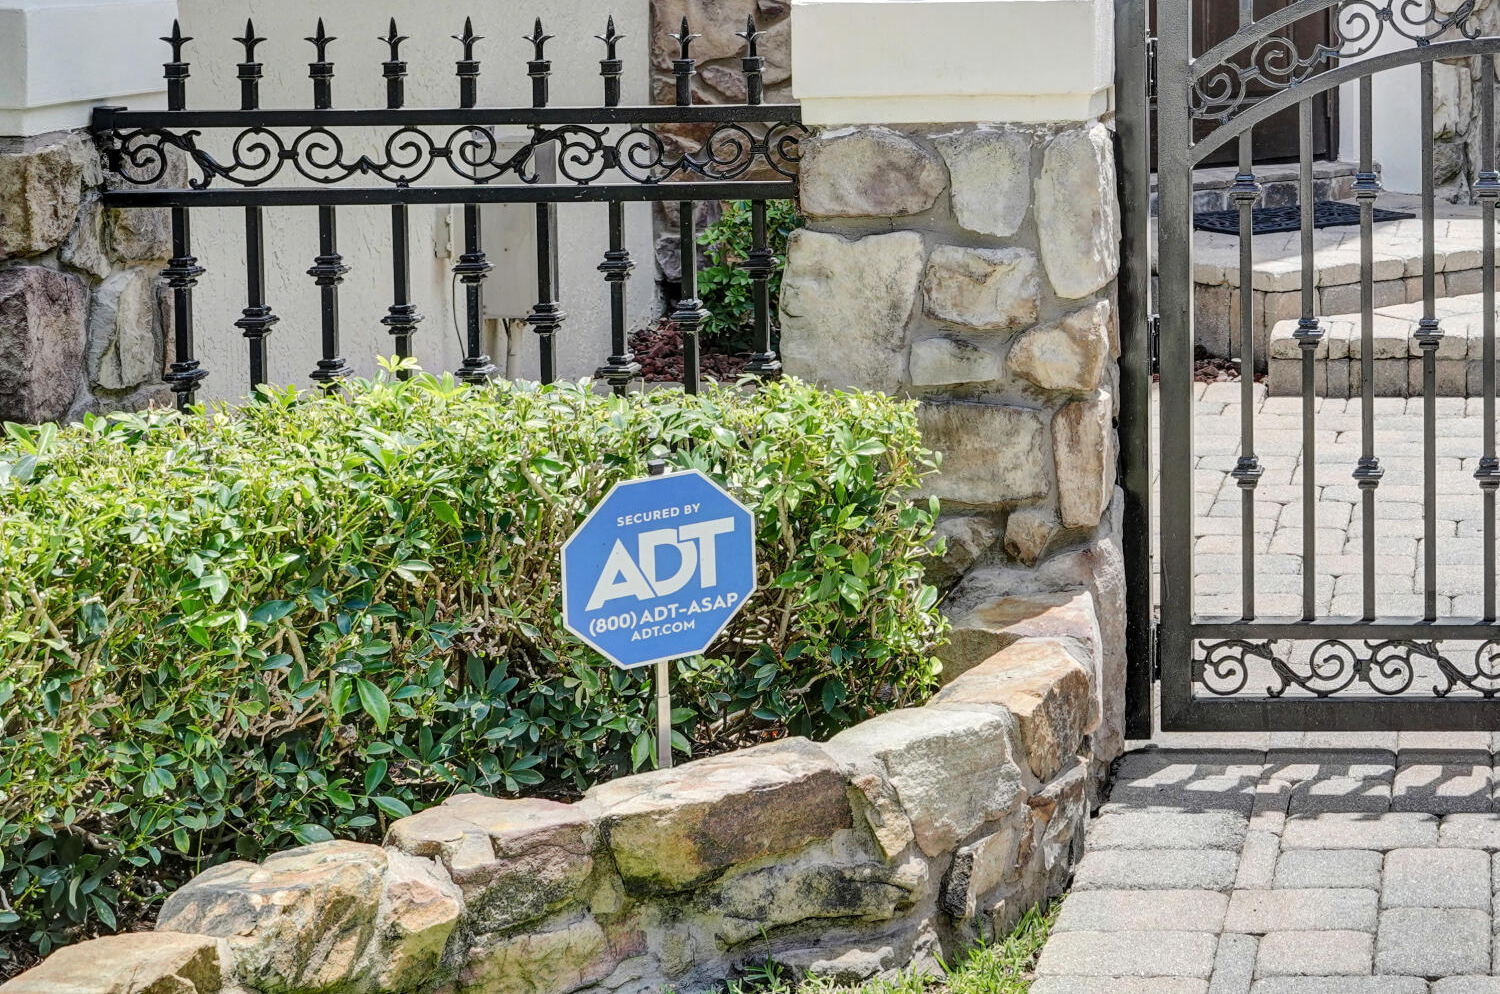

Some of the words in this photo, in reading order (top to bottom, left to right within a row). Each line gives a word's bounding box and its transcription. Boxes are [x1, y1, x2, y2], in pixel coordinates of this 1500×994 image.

[617, 507, 679, 526] SECURED
[684, 503, 700, 515] BY
[585, 516, 735, 611] ADT
[589, 611, 636, 636] (800)
[640, 593, 738, 625] ADT-ASAP
[631, 619, 695, 641] ADT.COM
